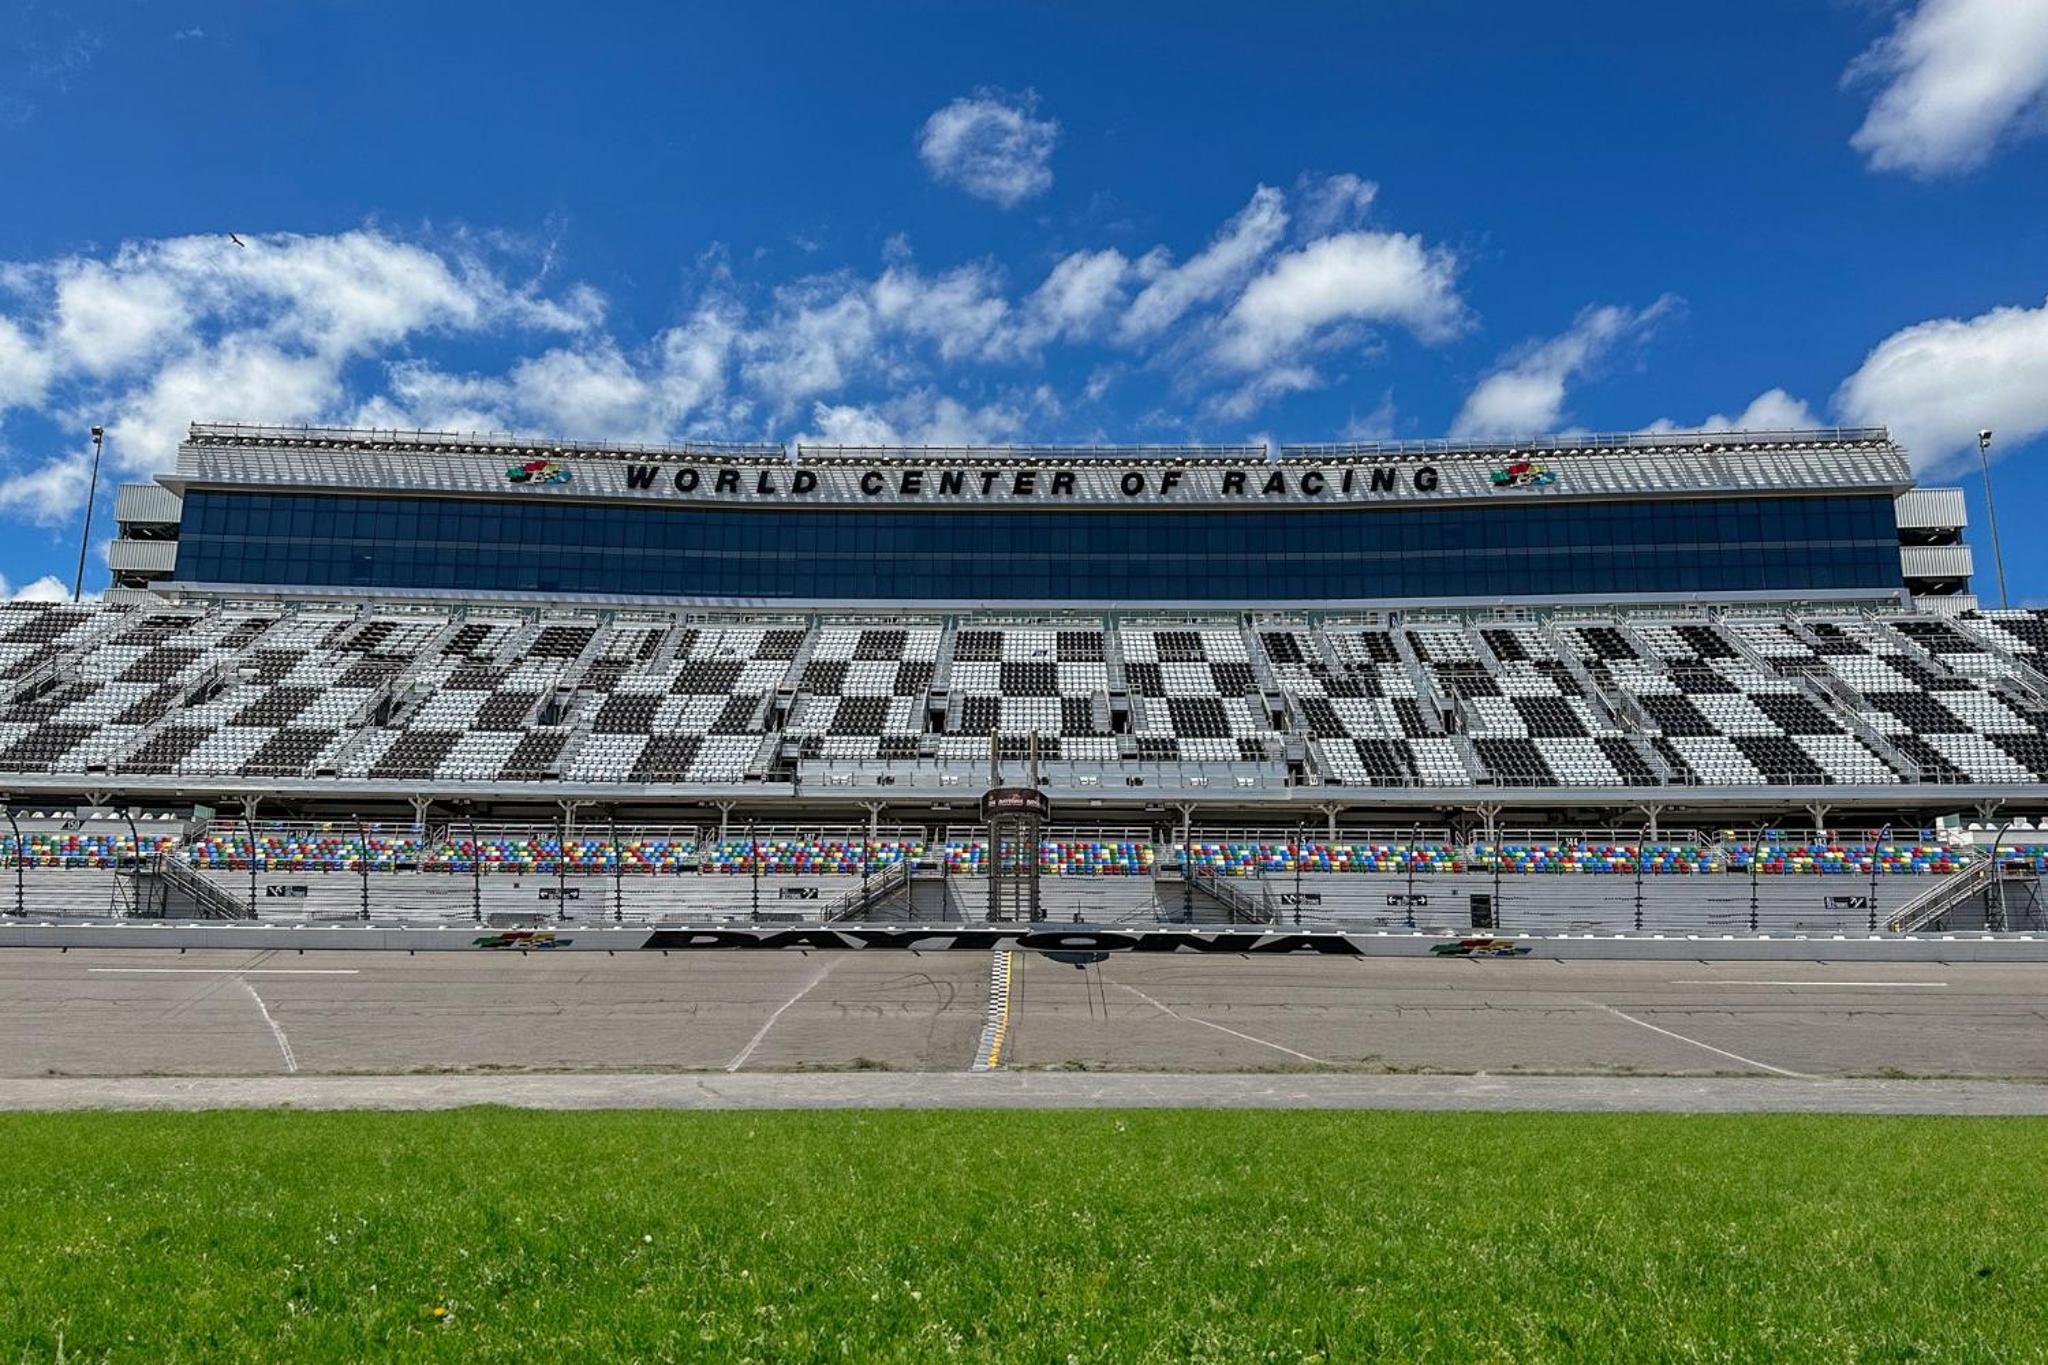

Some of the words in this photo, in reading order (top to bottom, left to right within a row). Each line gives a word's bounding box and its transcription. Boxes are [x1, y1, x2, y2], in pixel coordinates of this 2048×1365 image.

[626, 464, 817, 494] WORLD
[860, 469, 1076, 496] CENTER
[1121, 470, 1182, 496] OF
[1221, 466, 1439, 495] RACING
[67, 820, 80, 830] 150
[641, 930, 1364, 954] DAYTONA
